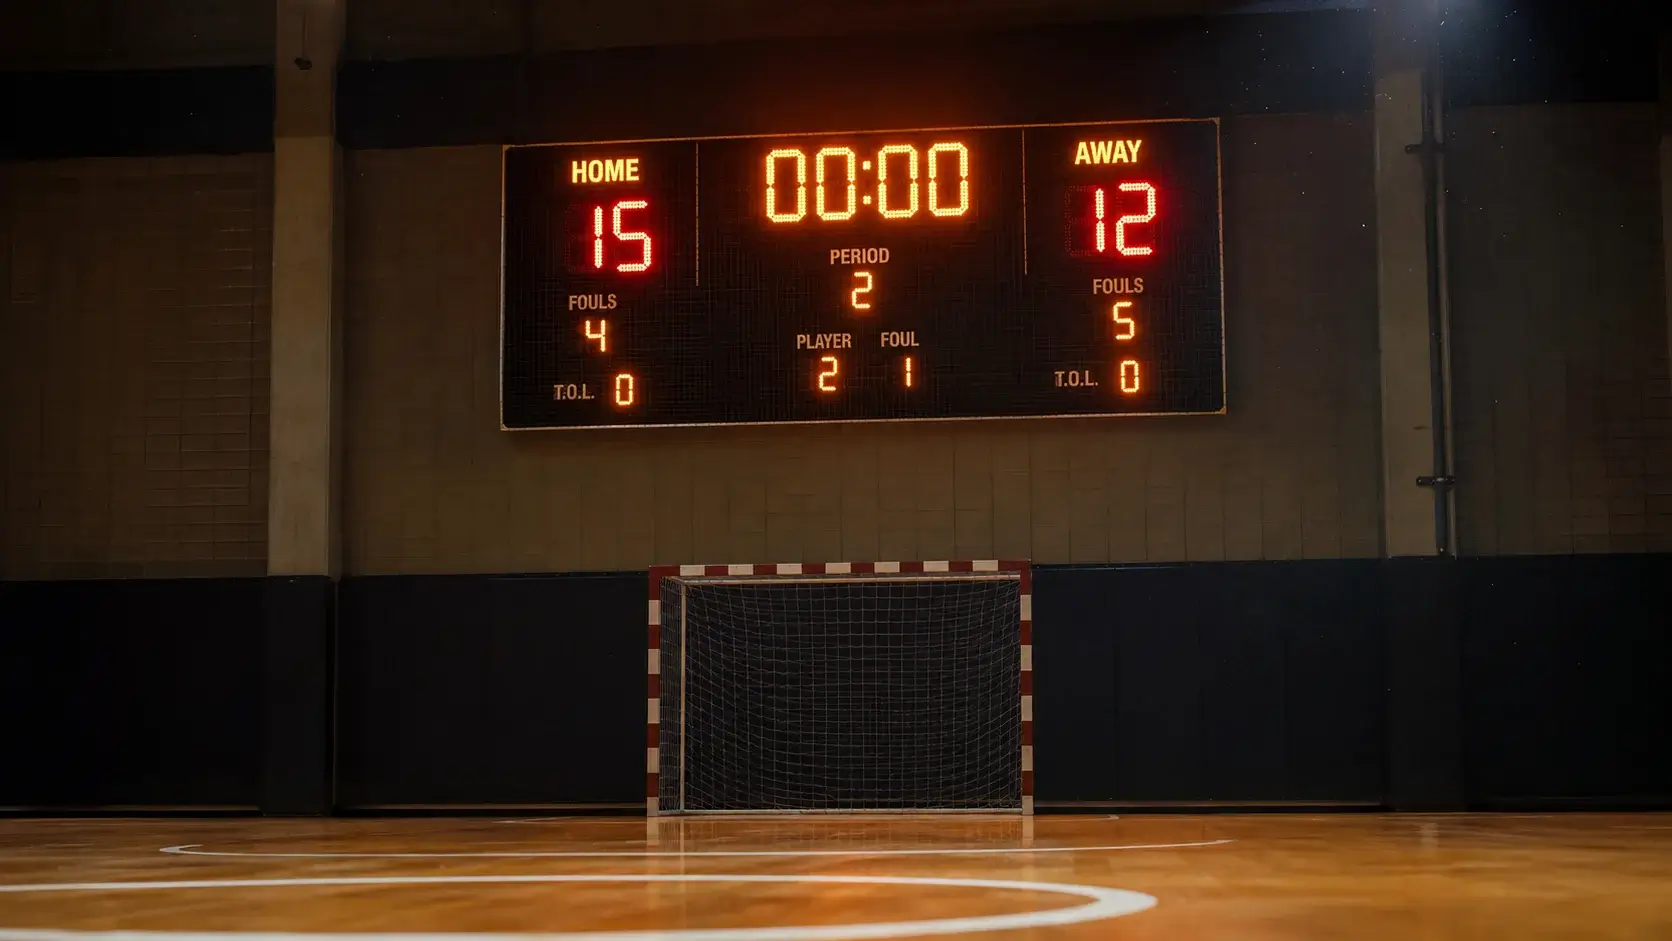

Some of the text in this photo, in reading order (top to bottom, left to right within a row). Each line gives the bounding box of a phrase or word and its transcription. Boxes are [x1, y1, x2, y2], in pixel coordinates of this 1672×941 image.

[1075, 139, 1142, 165] AWAY
[572, 158, 638, 184] HOME
[765, 142, 969, 223] 00:00
[1095, 182, 1157, 256] 12
[593, 200, 652, 272] 15
[830, 248, 889, 265] PERIOD
[569, 294, 617, 310] FOULS
[850, 271, 873, 310] 2
[1093, 277, 1143, 295] FOULS
[584, 320, 608, 352] 4
[1112, 301, 1135, 341] 5
[797, 333, 851, 349] PLAYER
[881, 331, 919, 348] FOUL
[818, 356, 839, 391] 2
[905, 357, 913, 387] 1
[1054, 360, 1140, 393] T.O.L. 0
[553, 373, 634, 406] T.O.L. 0
